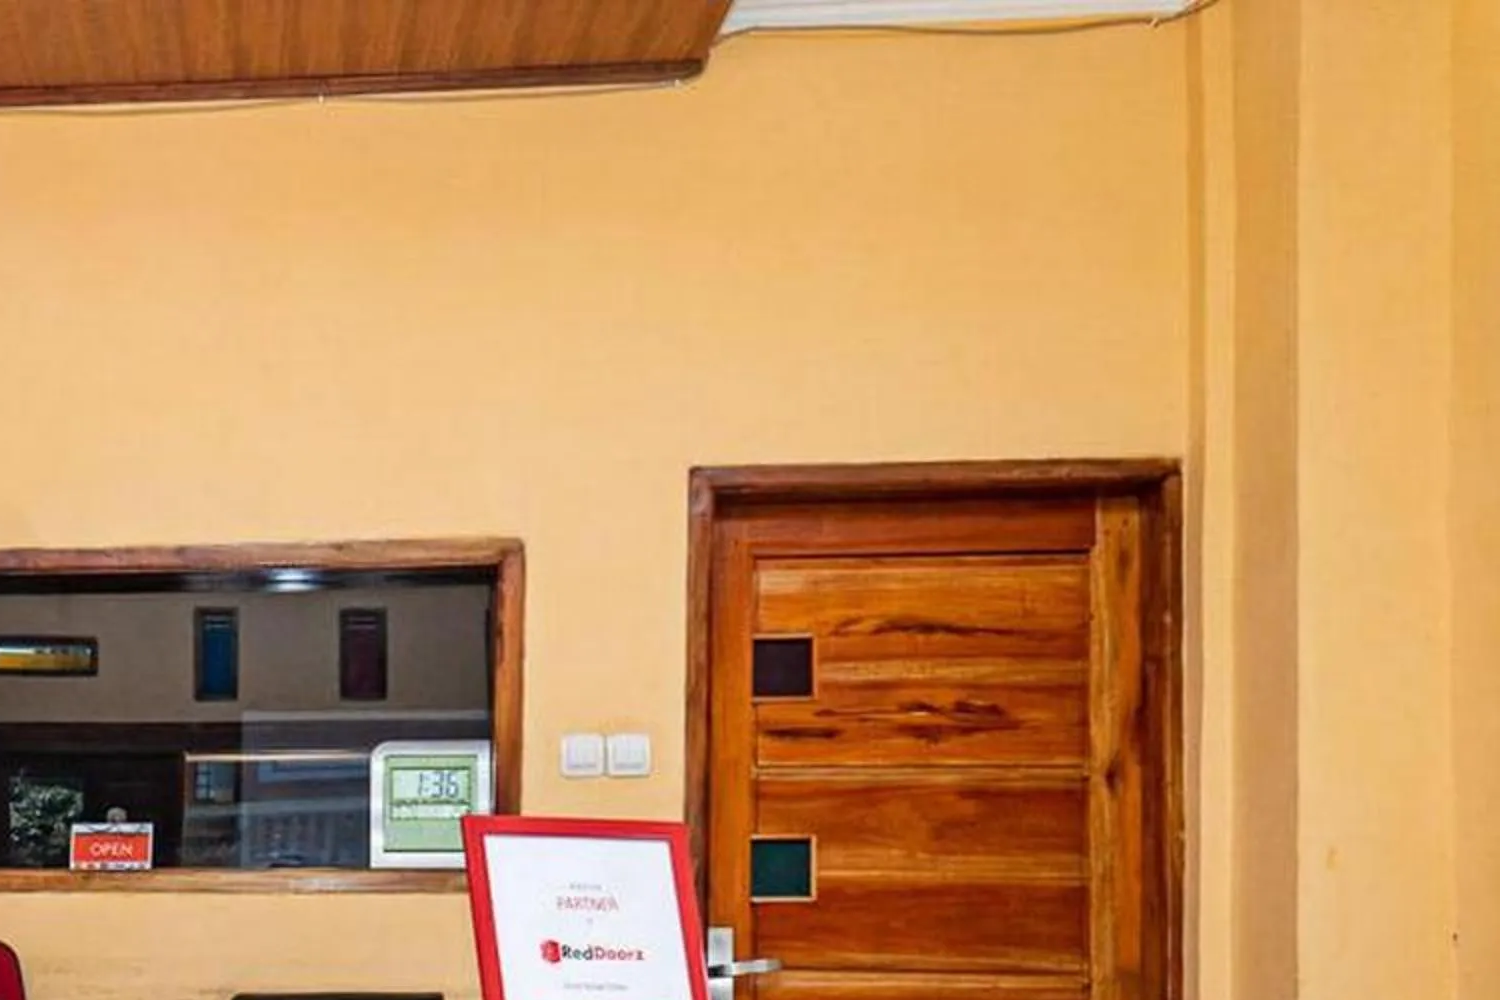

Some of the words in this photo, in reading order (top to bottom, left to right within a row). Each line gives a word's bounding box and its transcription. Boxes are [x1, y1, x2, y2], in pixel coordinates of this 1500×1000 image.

[418, 771, 460, 798] 1:36
[90, 841, 134, 858] OPEN
[561, 944, 645, 961] RedDoorz
